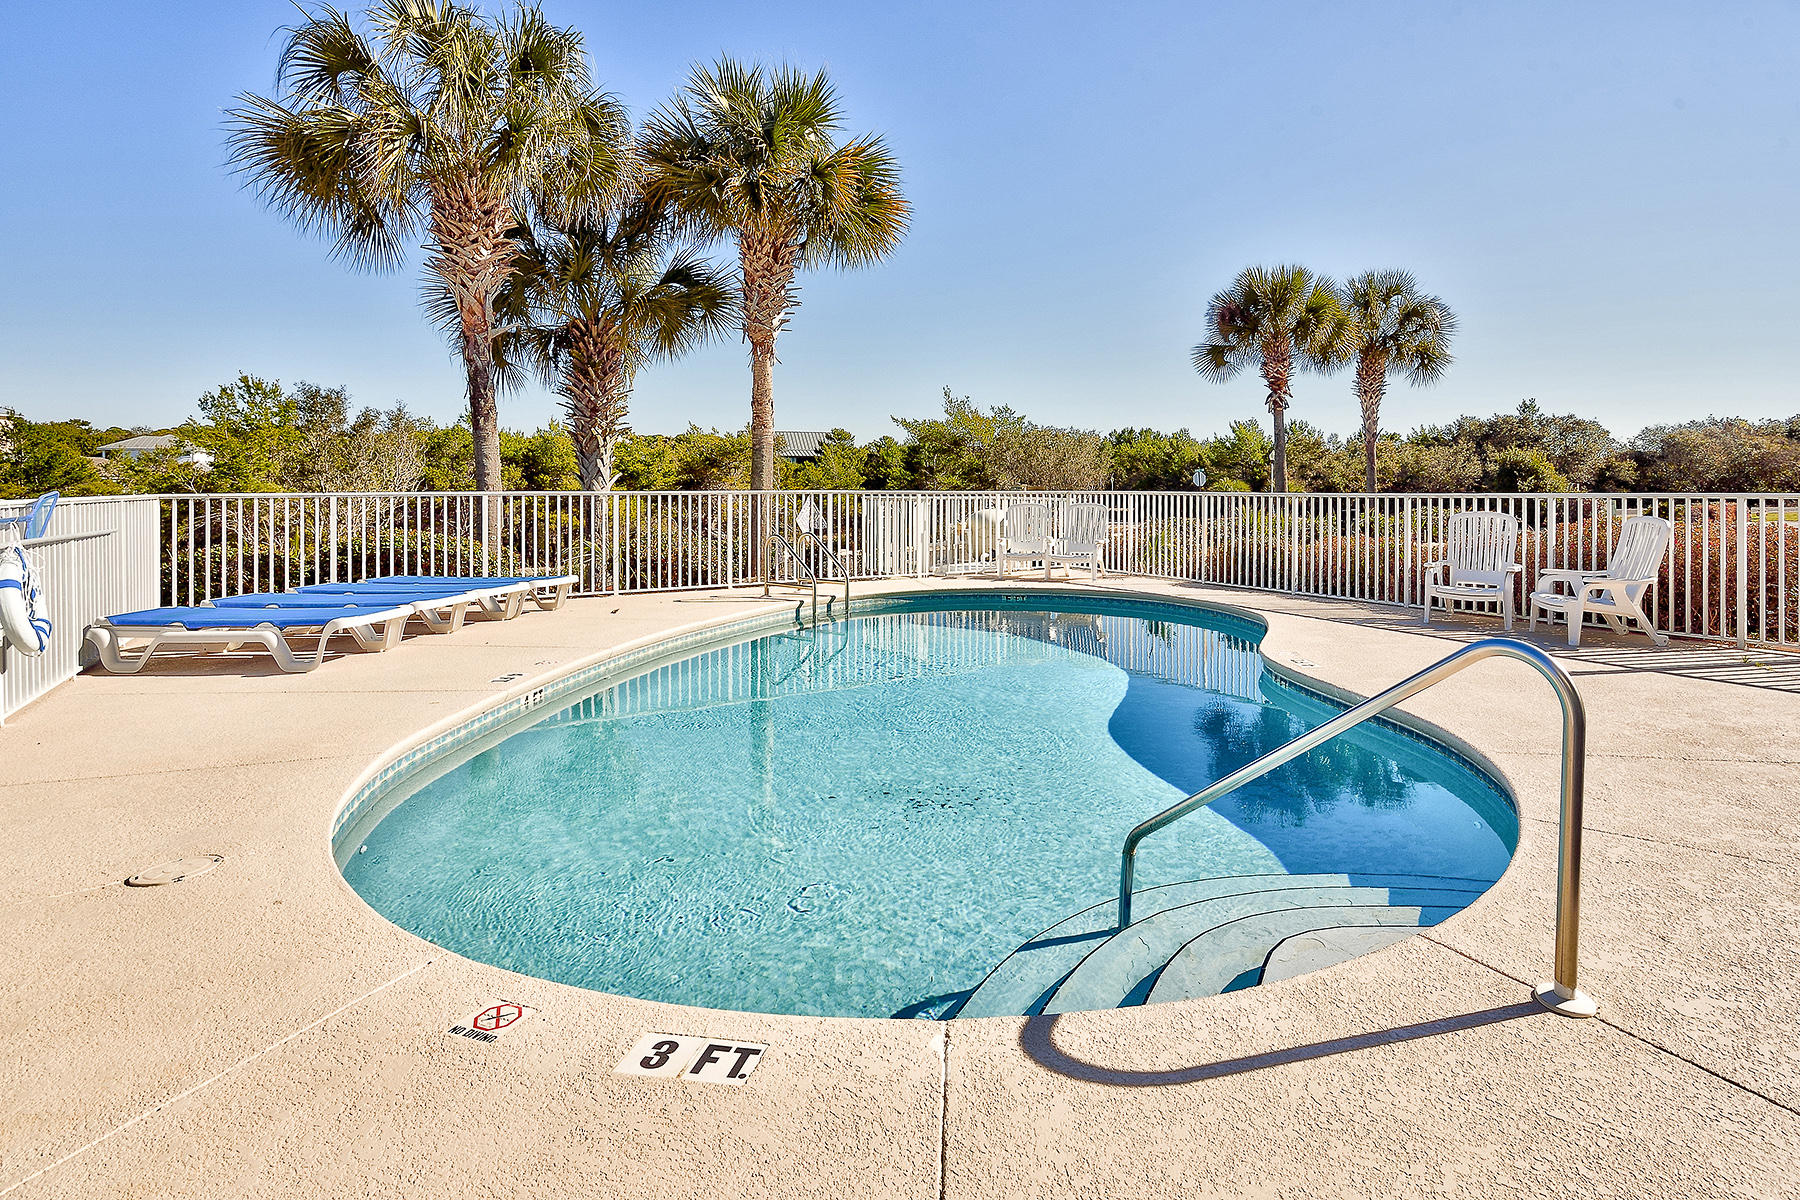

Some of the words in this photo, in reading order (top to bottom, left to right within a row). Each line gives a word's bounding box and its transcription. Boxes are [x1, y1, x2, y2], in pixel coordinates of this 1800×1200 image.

[447, 1025, 467, 1035] NO
[461, 1028, 498, 1044] DIVING
[639, 1040, 679, 1070] 3
[689, 1043, 762, 1079] FT.
